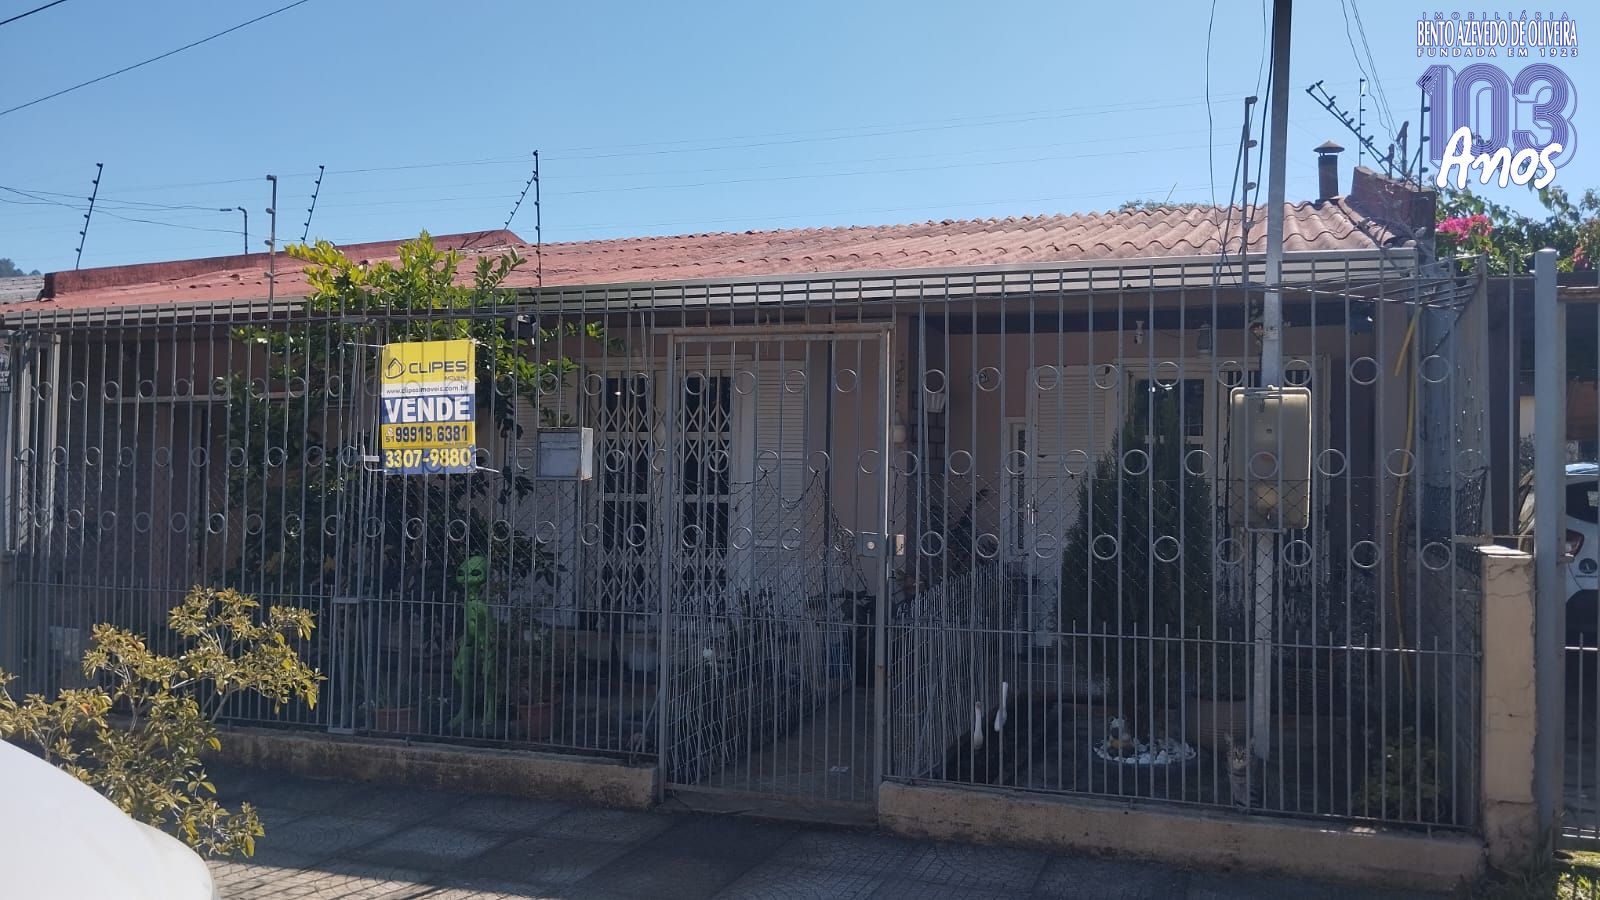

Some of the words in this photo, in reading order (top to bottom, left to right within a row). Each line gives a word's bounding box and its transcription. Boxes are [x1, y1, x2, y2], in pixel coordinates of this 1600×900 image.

[408, 360, 467, 374] CLIPES
[384, 396, 471, 423] VENDE
[395, 425, 468, 443] 99919.6381
[385, 448, 472, 468] 3307-9880
